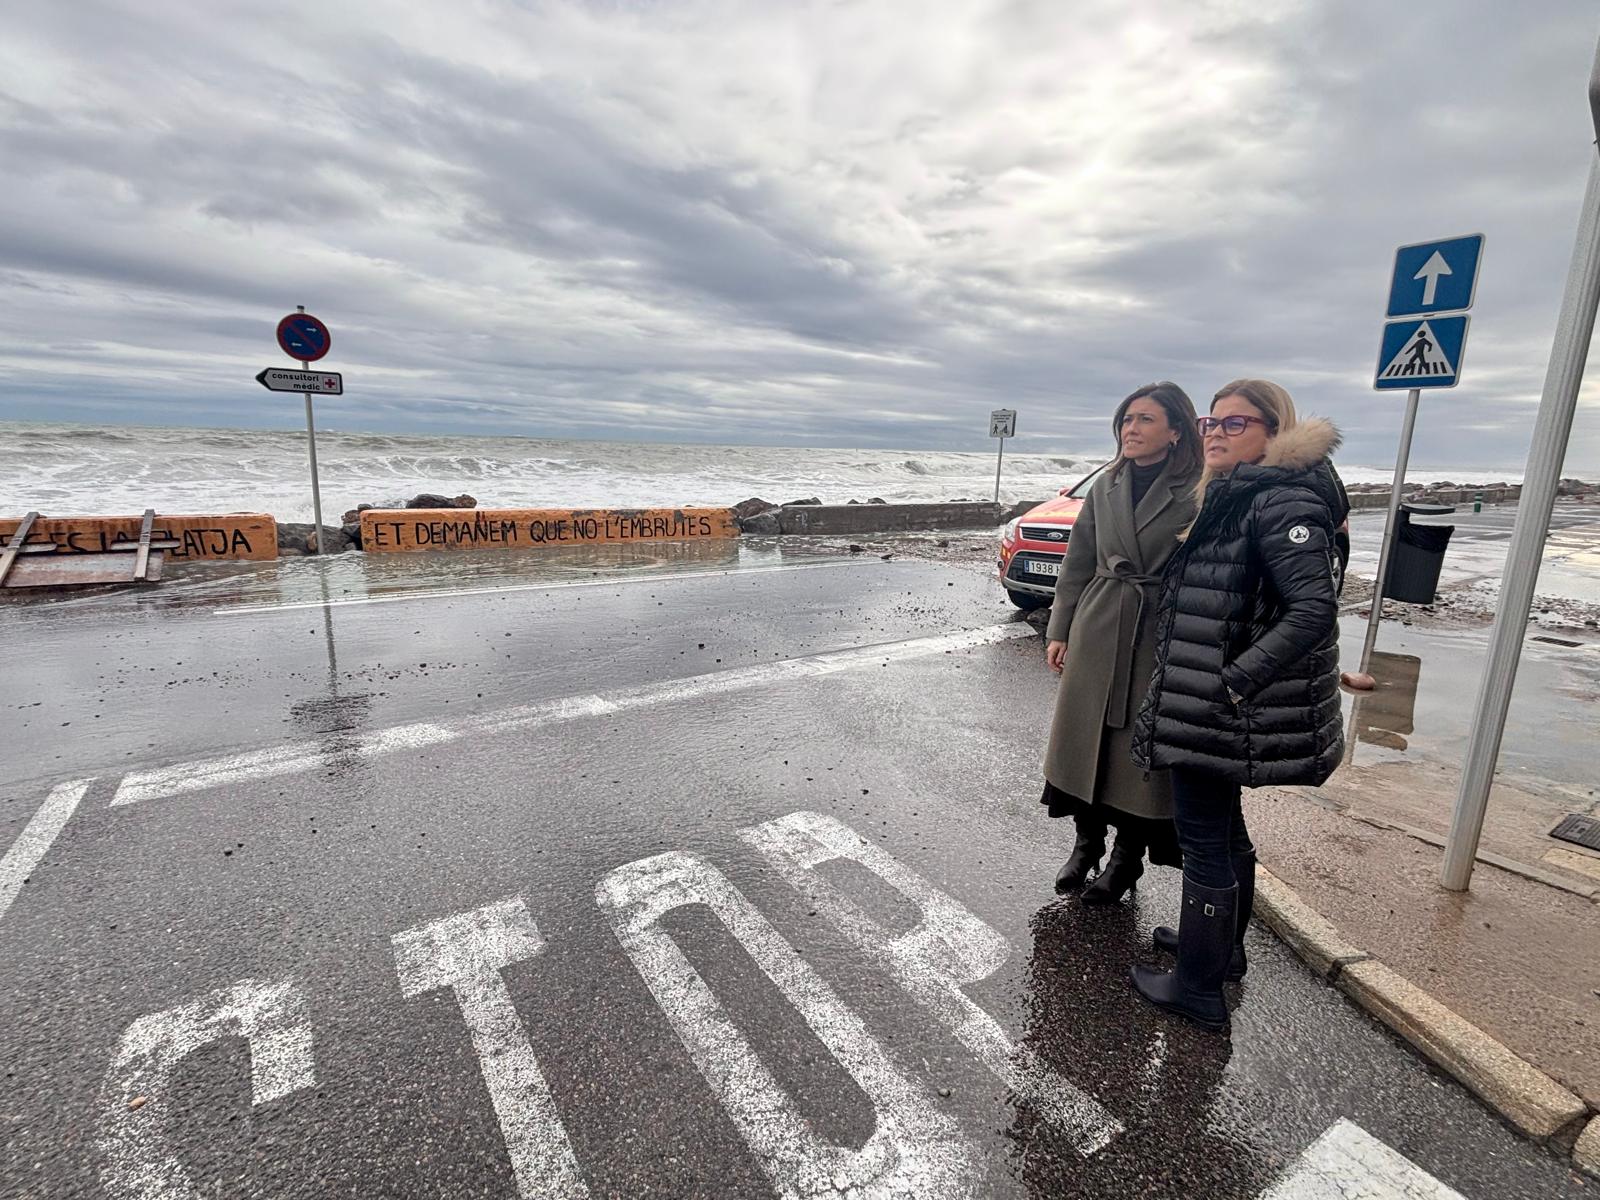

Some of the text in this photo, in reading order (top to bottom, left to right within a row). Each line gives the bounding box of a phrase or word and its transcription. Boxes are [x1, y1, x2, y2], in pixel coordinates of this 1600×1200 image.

[272, 373, 320, 382] consultori
[374, 522, 406, 546] ET
[530, 519, 568, 544] QUE
[573, 518, 598, 541] NO
[605, 516, 712, 539] L'EMBRUTES
[1031, 562, 1054, 574] 1938
